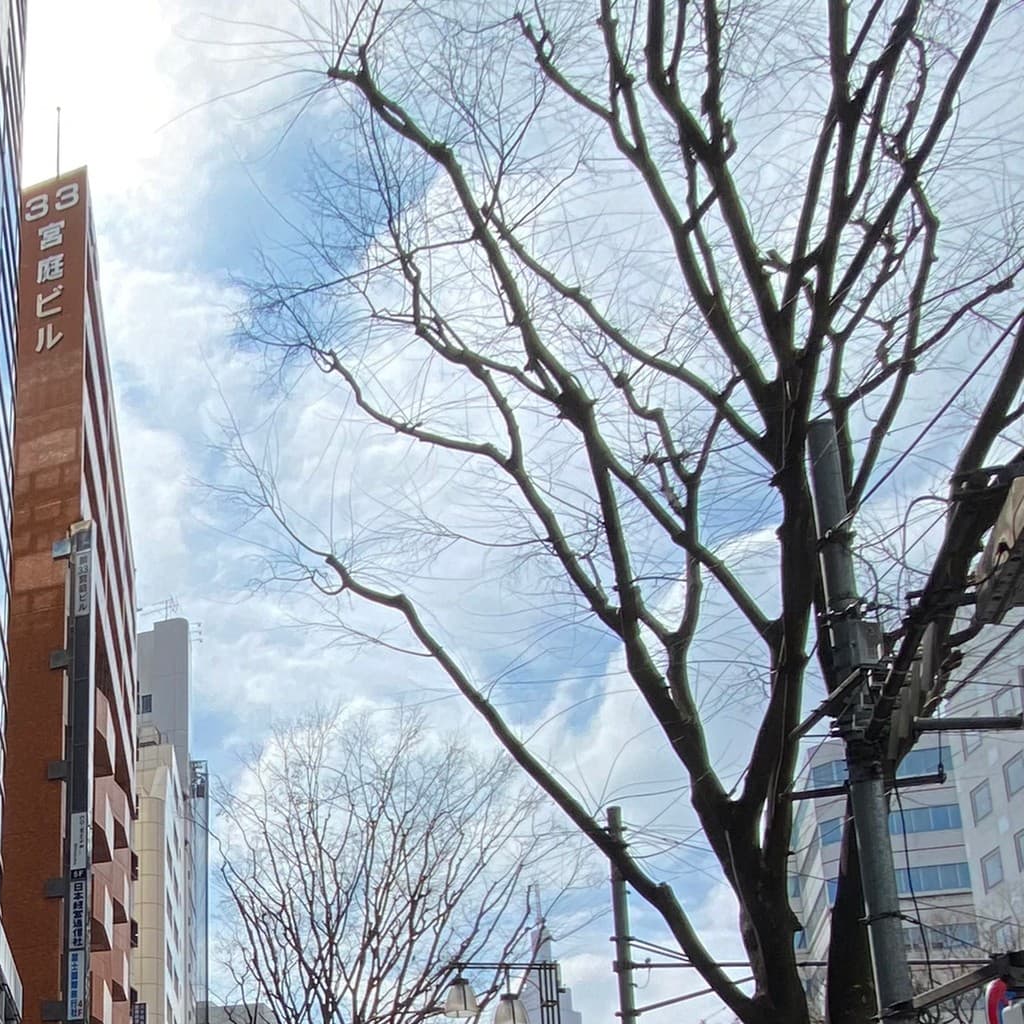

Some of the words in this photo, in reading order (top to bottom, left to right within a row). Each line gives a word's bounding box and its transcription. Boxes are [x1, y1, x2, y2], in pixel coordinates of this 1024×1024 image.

[25, 183, 80, 222] 33
[35, 220, 66, 353] 宮庭ビル
